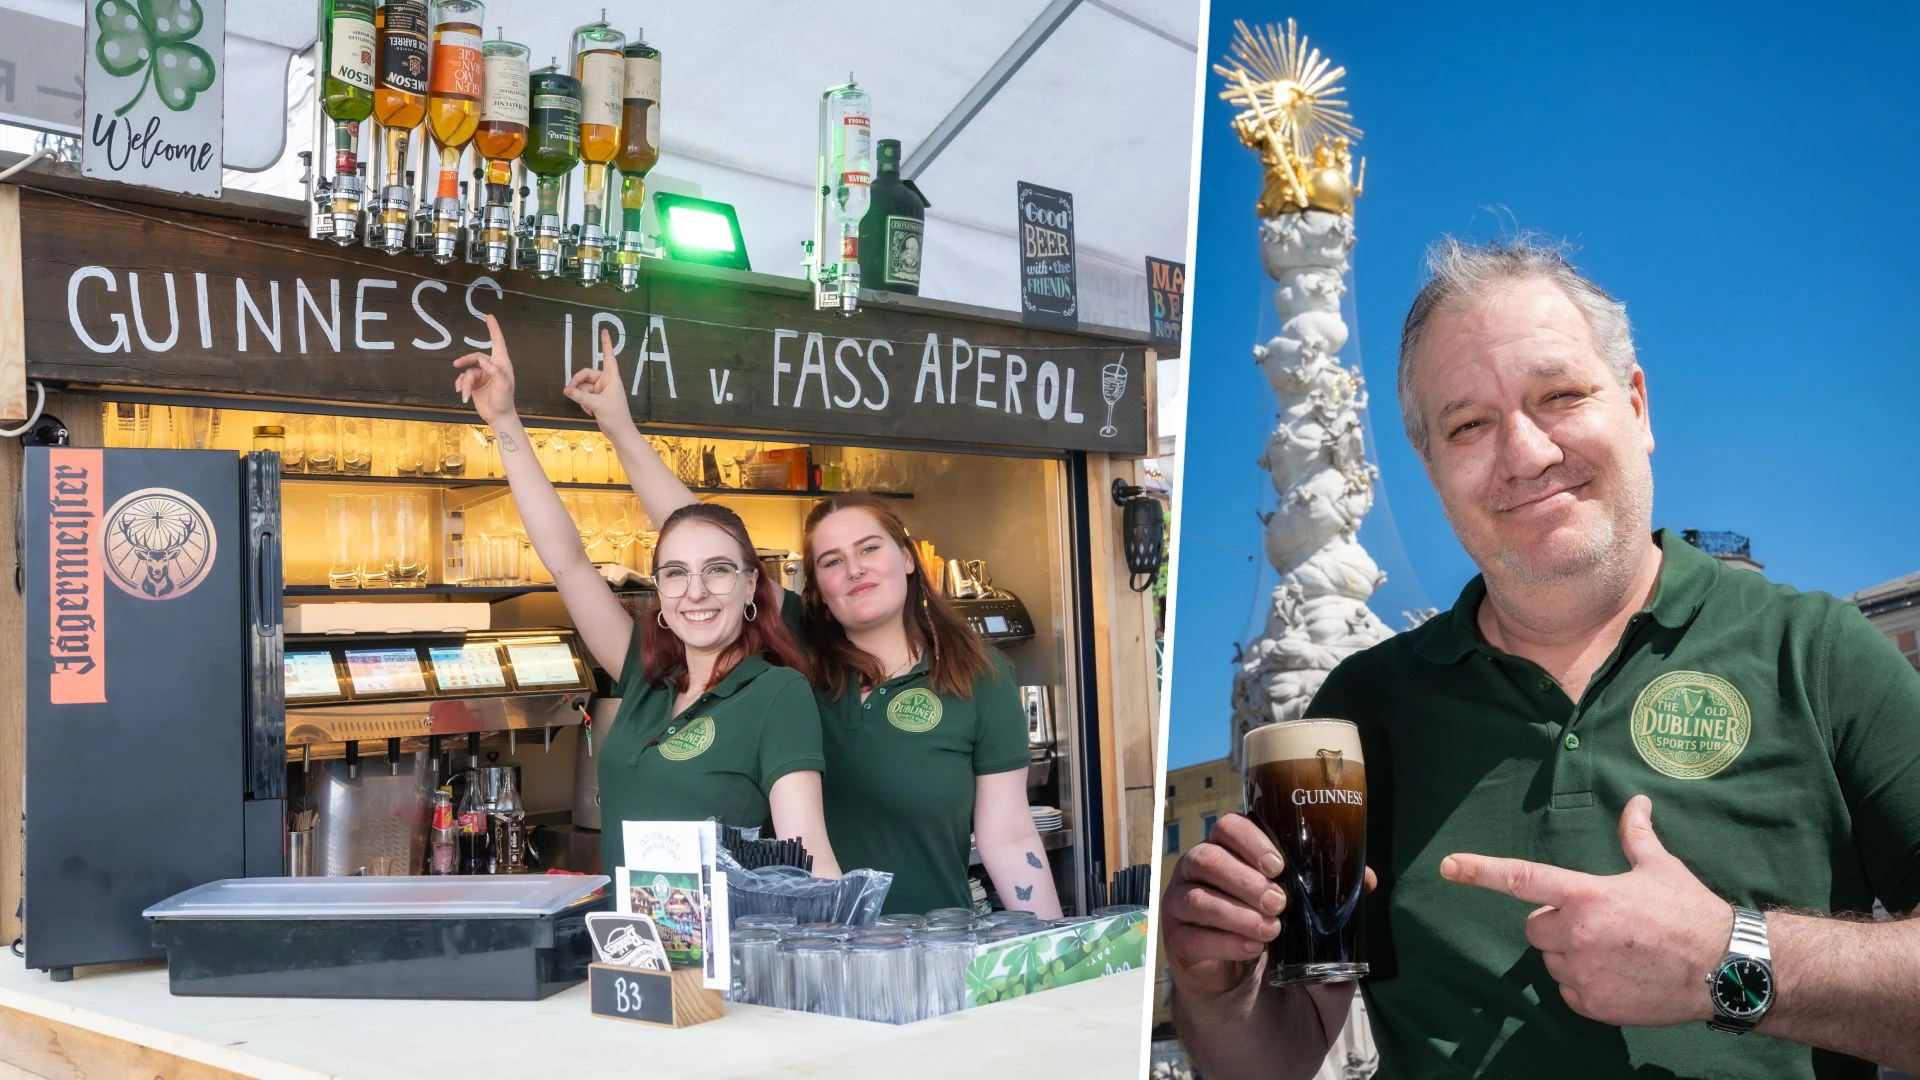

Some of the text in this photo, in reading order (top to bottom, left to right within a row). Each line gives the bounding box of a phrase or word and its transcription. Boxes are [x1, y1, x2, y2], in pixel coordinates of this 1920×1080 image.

[389, 36, 418, 49] BARREL
[458, 48, 475, 62] GIE
[454, 70, 474, 82] MO
[462, 60, 480, 74] RAN
[387, 71, 428, 92] AMESON
[455, 80, 480, 95] GLEN
[93, 112, 214, 173] Welcome
[1025, 202, 1068, 229] Good
[1024, 223, 1070, 257] BEER
[1027, 260, 1072, 275] with the
[1027, 277, 1071, 300] FRIENDS
[1153, 290, 1183, 322] BE
[1155, 319, 1180, 340] NOT
[67, 265, 1084, 425] GUINNESS IPA v. FASS APEROL
[893, 701, 936, 725] DUBLINER
[1657, 700, 1728, 717] THE OLD
[1640, 706, 1740, 745] DUBLINER
[677, 732, 708, 750] LINER
[1656, 736, 1721, 751] SPORTS PUB
[1291, 788, 1363, 806] GUINNESS
[615, 976, 642, 1013] B3
